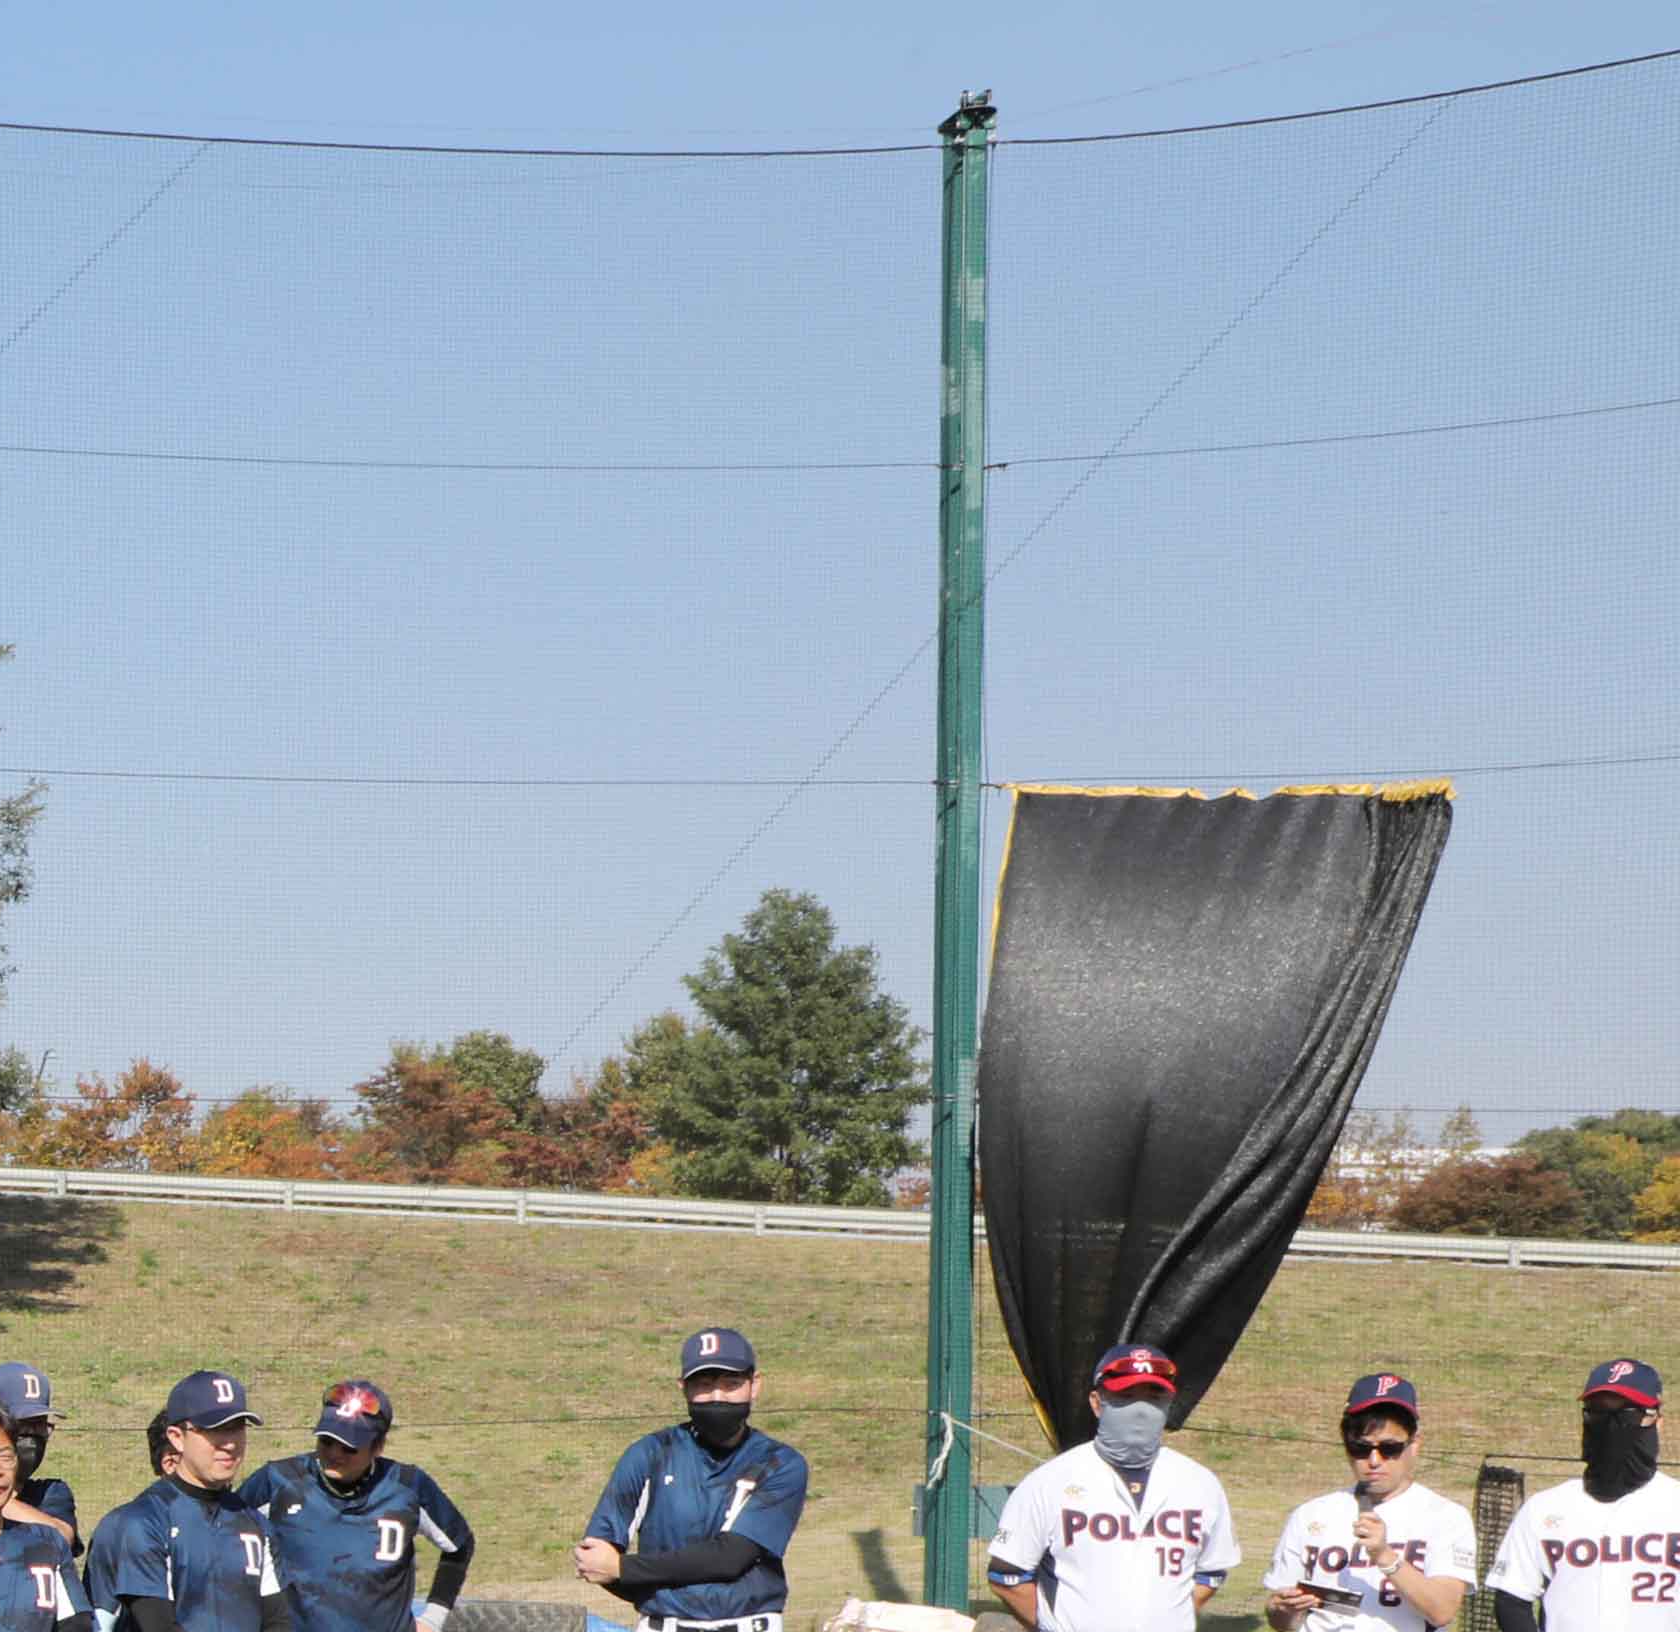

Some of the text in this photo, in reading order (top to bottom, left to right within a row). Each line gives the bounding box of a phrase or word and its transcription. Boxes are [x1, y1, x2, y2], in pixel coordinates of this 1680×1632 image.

[699, 1333, 720, 1356] D
[24, 1373, 41, 1399] D
[1375, 1375, 1400, 1397] P
[1608, 1361, 1634, 1383] P
[213, 1378, 234, 1403] D
[239, 1532, 263, 1577] D
[376, 1519, 405, 1562] D
[1541, 1532, 1680, 1577] POLICE
[1155, 1547, 1185, 1577] 19
[31, 1566, 55, 1608] D
[1631, 1571, 1676, 1602] 22
